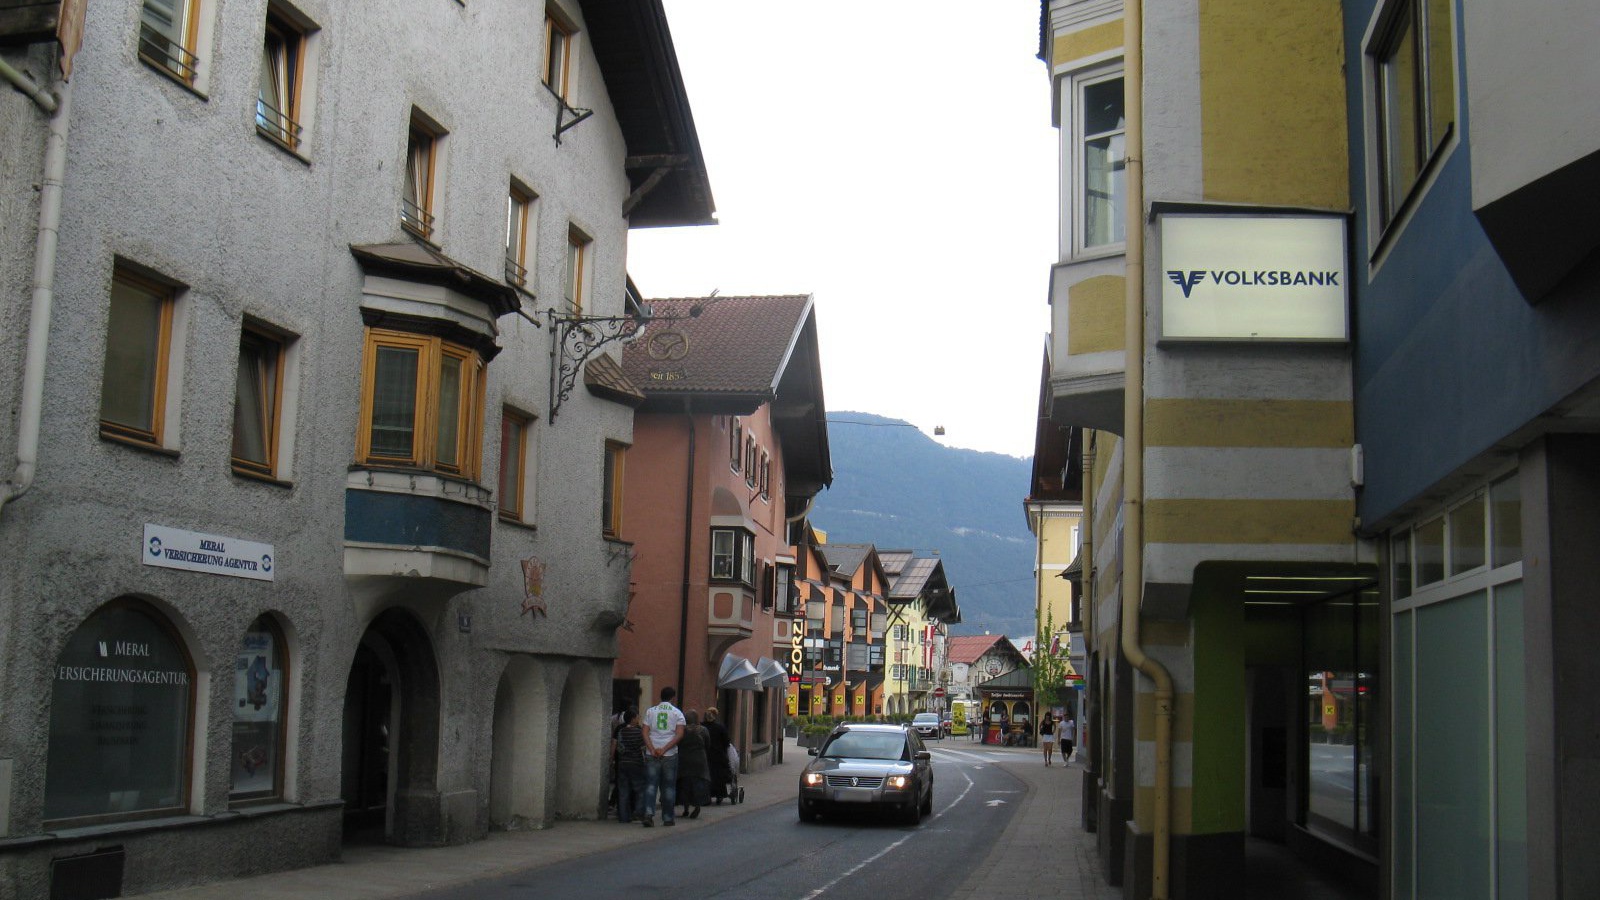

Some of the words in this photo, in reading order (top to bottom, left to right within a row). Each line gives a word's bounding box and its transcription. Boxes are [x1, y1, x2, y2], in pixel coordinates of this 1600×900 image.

[1211, 270, 1339, 286] VOLKSBANK
[200, 539, 226, 553] MERAL
[164, 549, 224, 567] VERSICHERUNG
[224, 557, 258, 571] AGENTUR
[115, 641, 150, 656] MERAL
[791, 618, 804, 676] ZORZI
